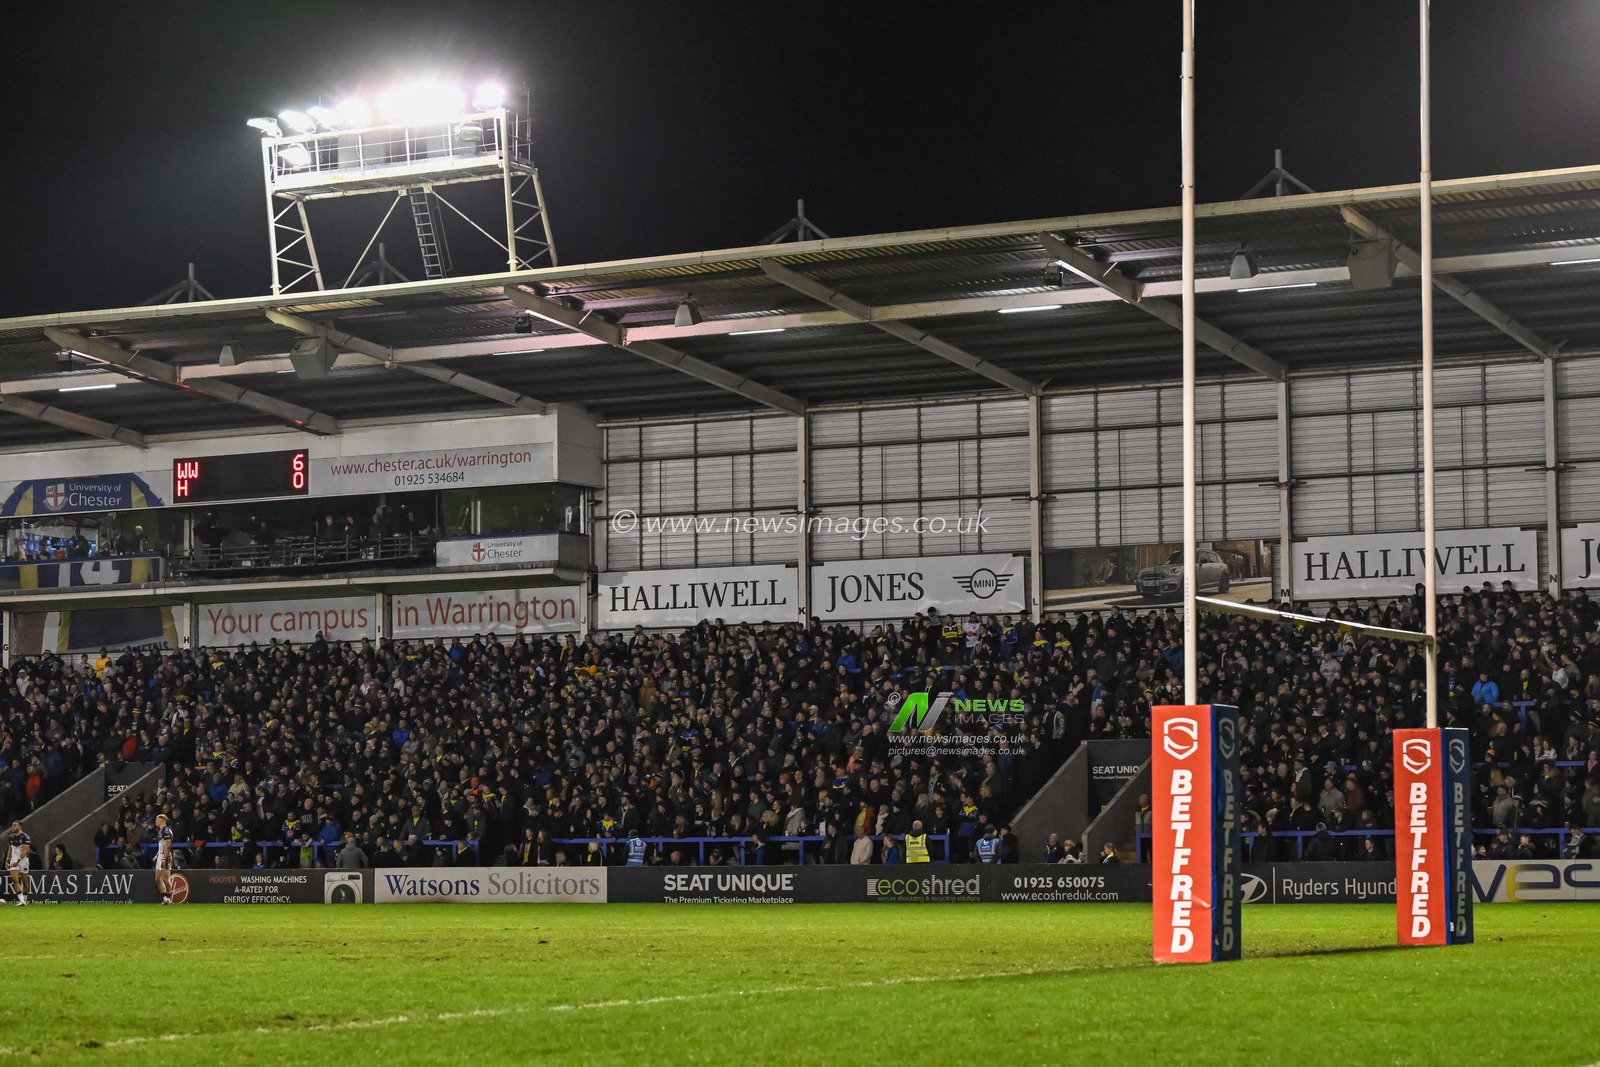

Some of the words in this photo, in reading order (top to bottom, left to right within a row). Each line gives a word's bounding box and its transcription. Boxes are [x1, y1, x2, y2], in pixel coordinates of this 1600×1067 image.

[177, 462, 199, 479] WW
[292, 453, 304, 471] 6
[330, 450, 532, 476] www.chester.ac.uk/warrington
[177, 480, 188, 497] H
[292, 471, 304, 489] 0
[394, 474, 425, 487] 01925
[428, 471, 465, 485] 534684
[69, 484, 111, 493] University
[113, 483, 122, 492] of
[69, 492, 122, 507] Chester
[487, 541, 516, 549] University
[487, 549, 522, 559] Chester
[1304, 543, 1525, 581] HALLIWELL
[973, 579, 995, 589] MINI
[1549, 574, 1558, 583] N
[609, 579, 787, 612] HALLIWELL
[825, 572, 925, 613] JONES
[1281, 589, 1290, 598] M
[396, 600, 419, 627] in
[425, 595, 576, 630] Warrington
[798, 606, 806, 615] K
[207, 608, 263, 635] Your
[269, 607, 368, 637] campus
[2, 643, 9, 651] G
[1092, 766, 1116, 774] SEAT
[107, 785, 126, 793] SEAT
[1170, 769, 1194, 953] BETFRED
[1222, 769, 1234, 951] BETFRED
[1410, 782, 1431, 938] BETFRED
[1453, 782, 1466, 937] BETFRED
[85, 874, 134, 895] LAW
[241, 875, 272, 884] WASHING
[273, 875, 307, 884] MACHINES
[384, 874, 480, 897] Watsons
[488, 871, 601, 896] Solicitors
[664, 874, 713, 891] SEAT
[1013, 877, 1053, 888] 01925
[1057, 876, 1105, 888] 650075
[234, 885, 263, 894] A-RATED
[264, 885, 279, 894] FOR
[1001, 889, 1119, 901] www.ecoshreduk.com
[1282, 878, 1339, 899] Ryders
[251, 895, 292, 903] EFFICIENCY.
[664, 896, 678, 904] The
[679, 896, 712, 904] Premium
[713, 896, 747, 904] Ticketing
[748, 896, 794, 904] Marketplace
